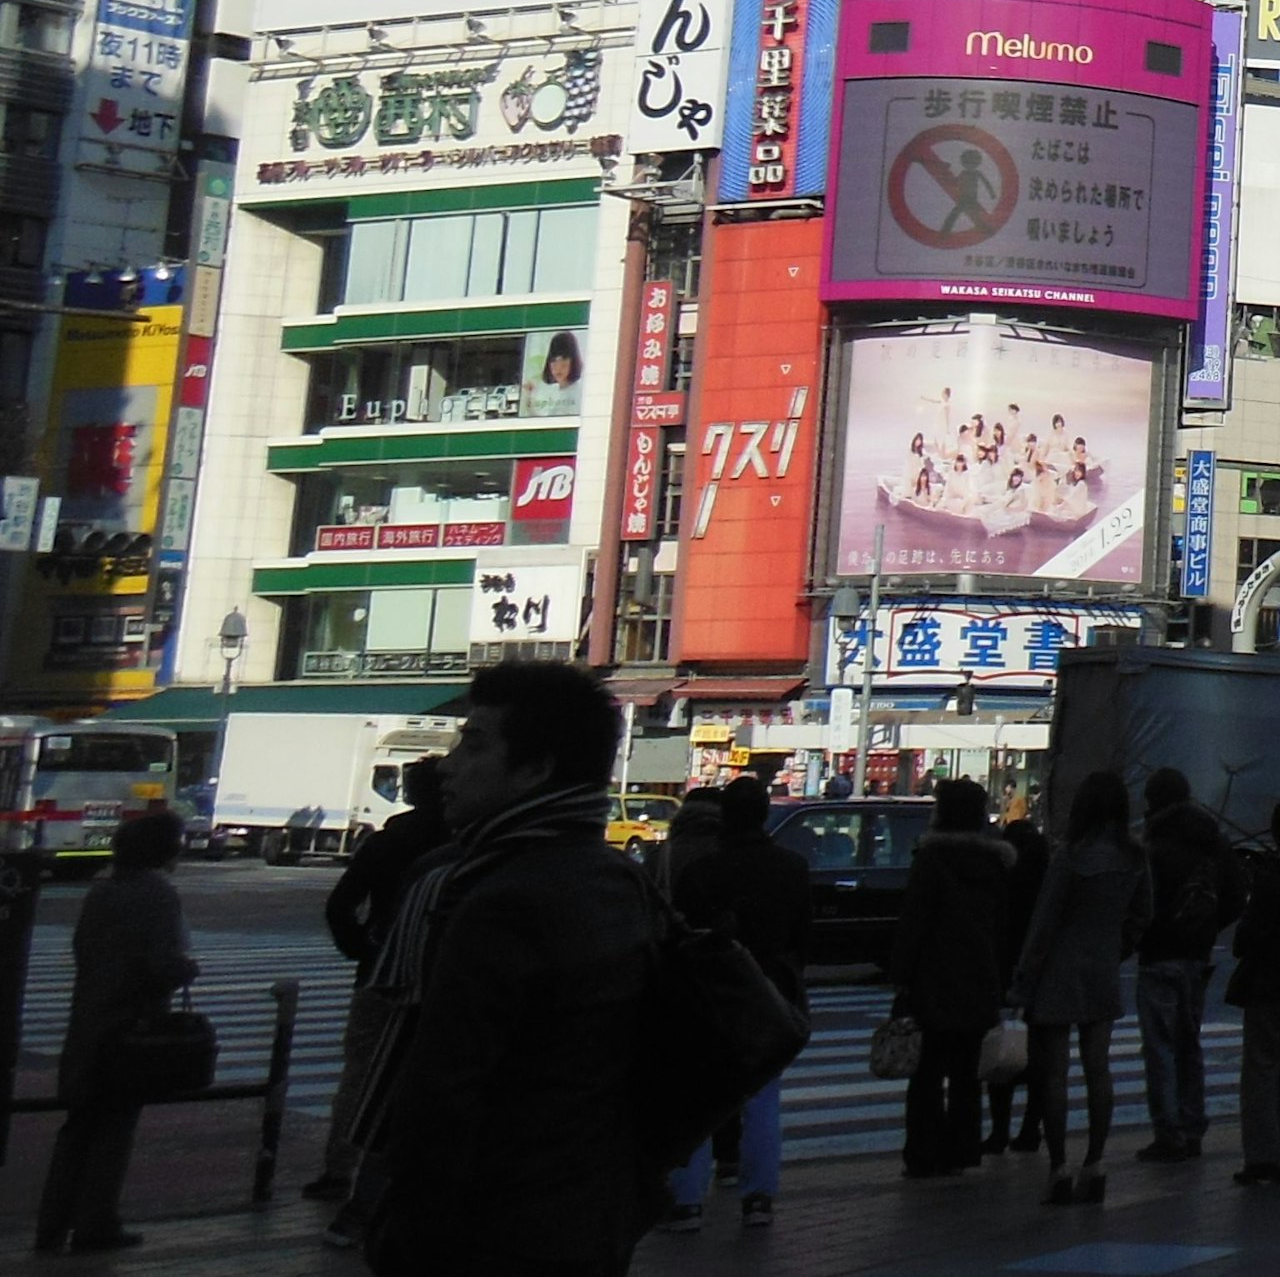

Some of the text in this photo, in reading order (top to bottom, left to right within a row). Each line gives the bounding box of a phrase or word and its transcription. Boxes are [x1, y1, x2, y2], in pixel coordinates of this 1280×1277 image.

[97, 30, 182, 70] 夜11時
[110, 64, 162, 97] まで
[128, 107, 176, 139] 地下
[923, 88, 1120, 131] 歩行喫煙禁止
[1030, 138, 1090, 164] たばこは
[1028, 175, 1146, 212] 決められた場所で
[1026, 217, 1116, 249] 吸いましょう
[940, 284, 1096, 303] WAKASA SEIKATSU CHANNEL
[639, 287, 668, 386] お好み焼
[517, 465, 575, 506] JTB
[627, 432, 653, 535] もんじゃ焼
[320, 530, 372, 548] 国内旅行
[381, 528, 434, 546] 海外旅行
[450, 523, 499, 534] ハネムーン
[1187, 459, 1211, 587] 大盛堂商事ビル
[848, 548, 1005, 566] 僕たの足跡は、先にある
